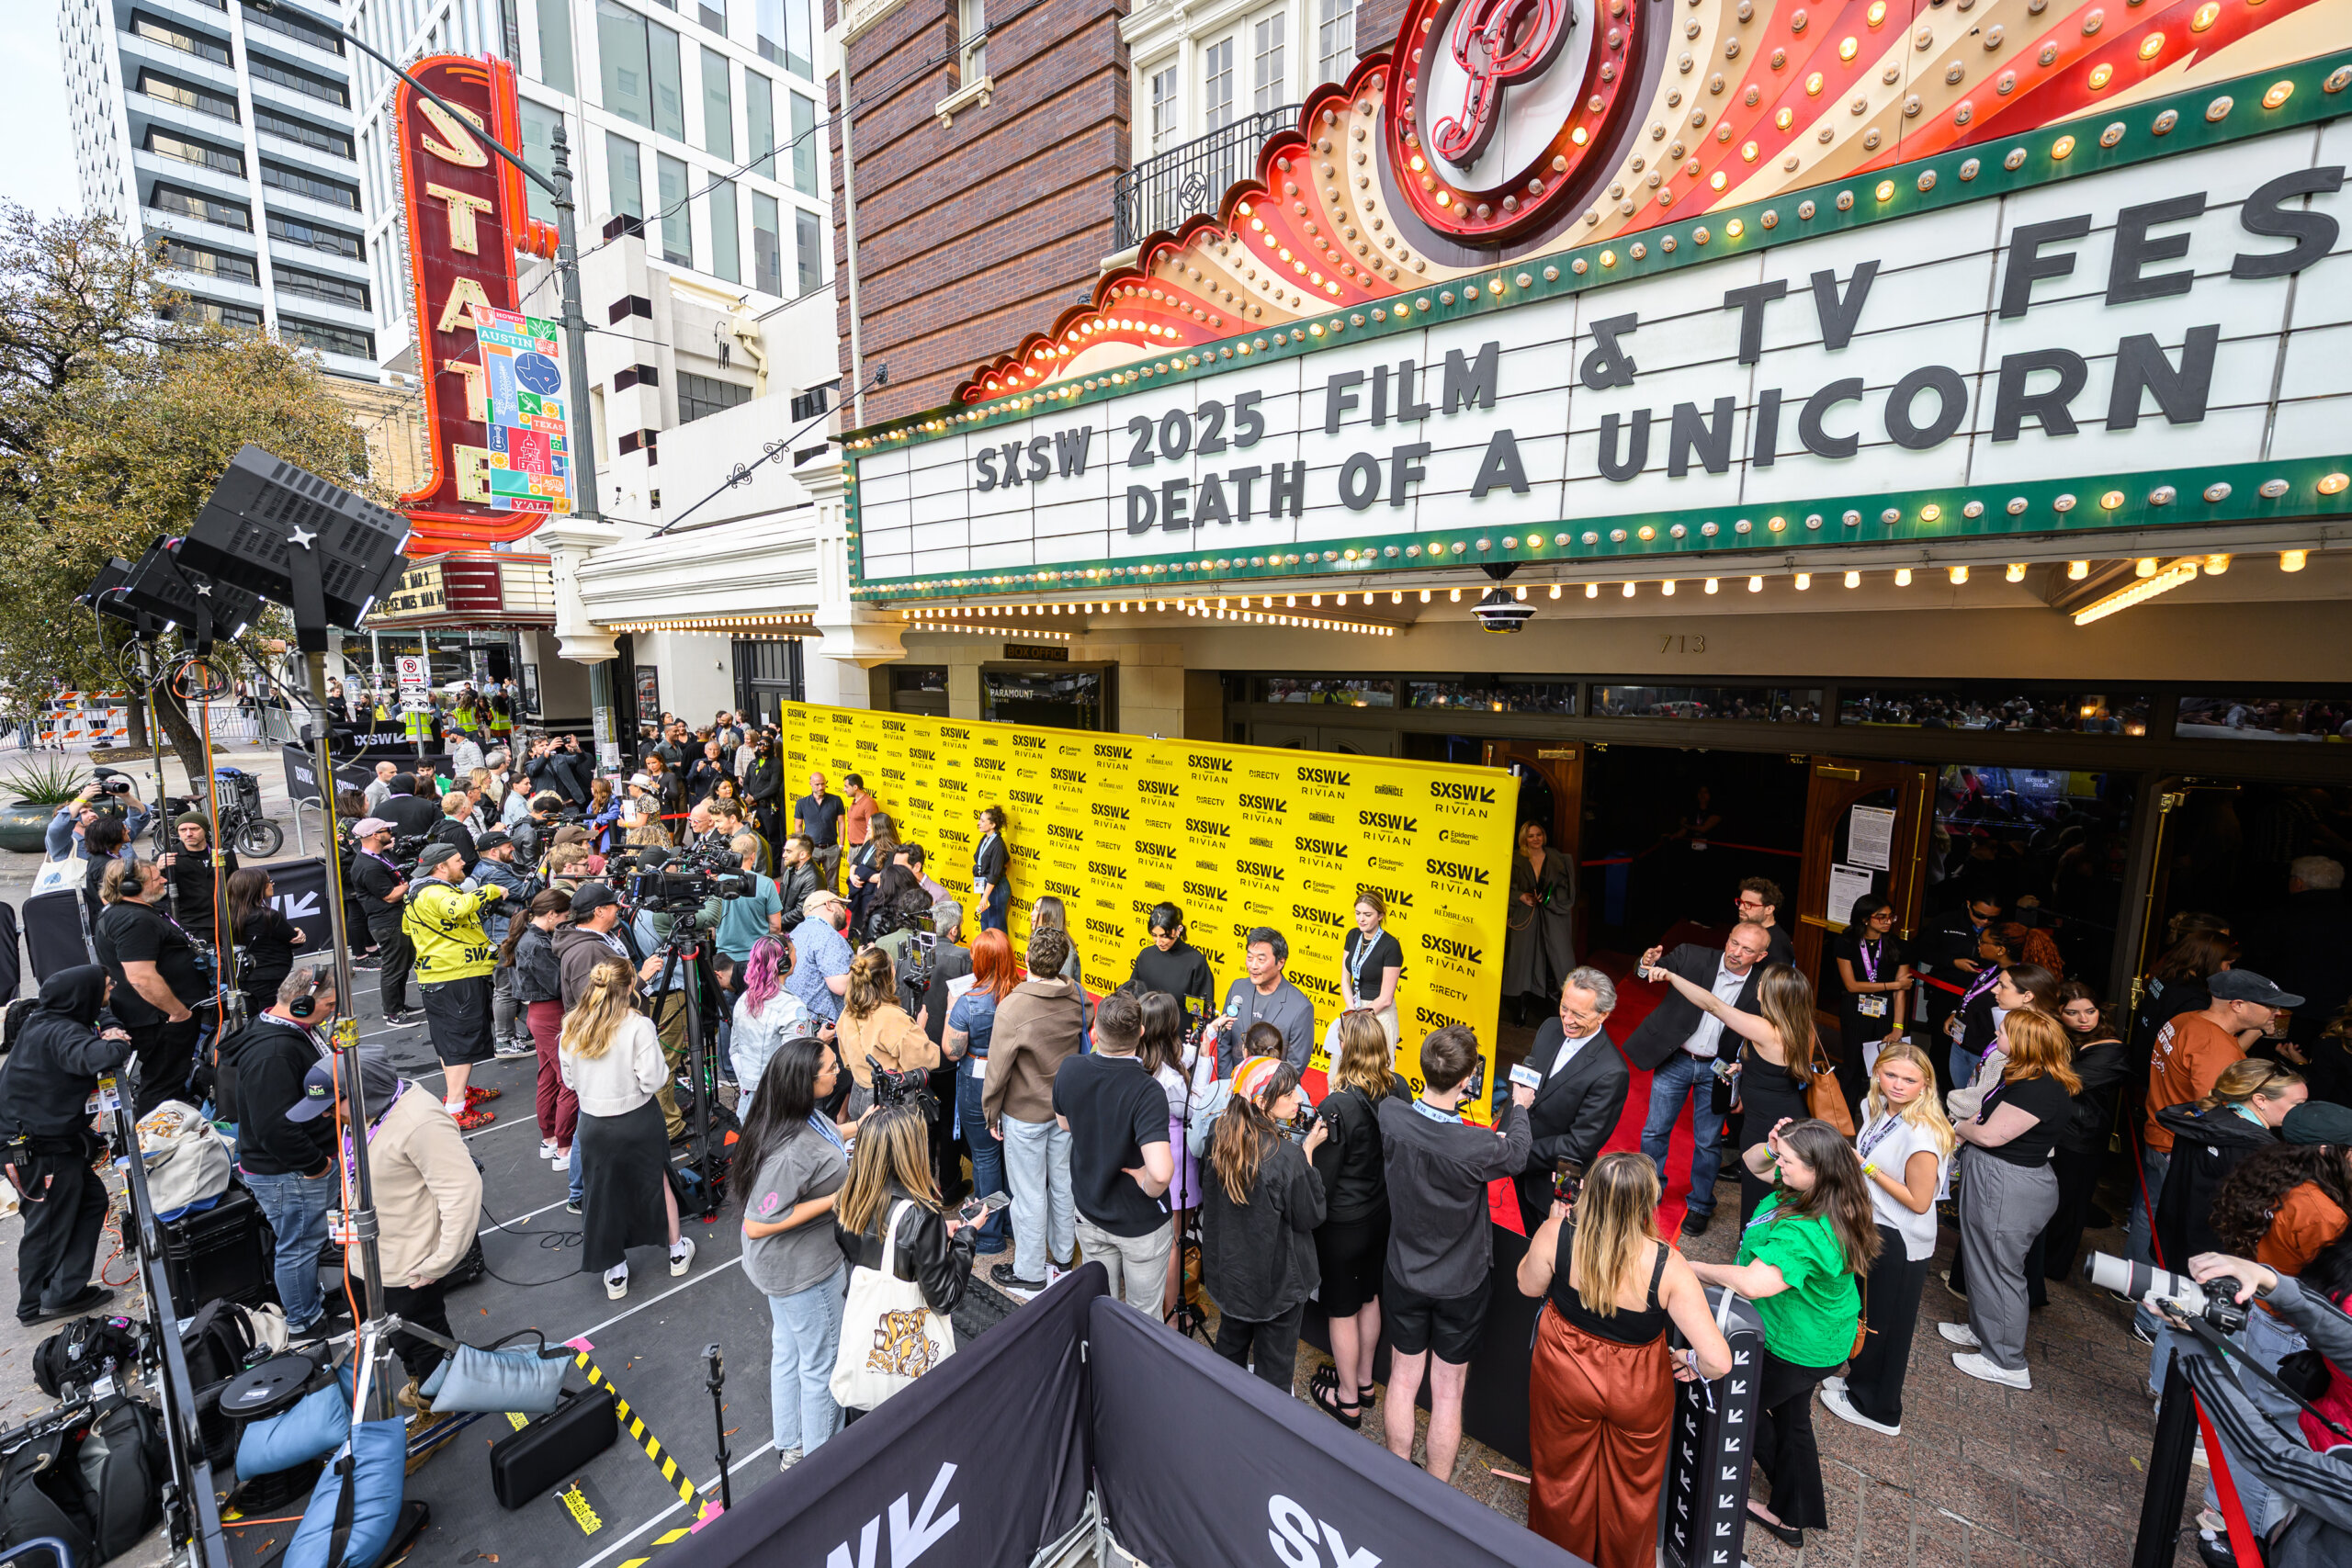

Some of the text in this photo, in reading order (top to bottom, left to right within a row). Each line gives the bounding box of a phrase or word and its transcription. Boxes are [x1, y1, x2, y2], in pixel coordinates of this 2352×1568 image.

[417, 97, 492, 503] STATE
[496, 312, 525, 322] HOWDY
[975, 166, 2345, 492] SXSW 2025 FILM & TV FES
[481, 330, 533, 349] AUSTIN
[534, 419, 564, 432] TEXAS
[1127, 323, 2220, 535] DEATH OF A UNICORN
[514, 500, 550, 512] Y'ALL
[1660, 634, 1705, 654] 713
[1007, 647, 1067, 660] BOX OFFICE
[990, 689, 1034, 699] PARAMOUNT
[787, 708, 801, 720] SXSW
[832, 714, 847, 724] SXSW
[882, 720, 899, 731] SXSW
[809, 733, 823, 743] SXSW
[941, 727, 963, 739] SXSW
[856, 739, 873, 752] SXSW
[943, 741, 967, 750] RIVIAN
[1012, 735, 1037, 748] SXSW
[788, 750, 802, 761] SXSW
[910, 748, 929, 760] SXSW
[1015, 750, 1042, 759] RIVIAN
[1094, 744, 1122, 760] SXSW
[831, 759, 846, 769] SXSW
[911, 761, 933, 770] RIVIAN
[974, 757, 997, 772] SXSW
[1097, 761, 1128, 771] RIVIAN
[1188, 754, 1220, 772] SXSW
[881, 767, 899, 781] SXSW
[976, 773, 1001, 781] RIVIAN
[1051, 767, 1078, 784] SXSW
[1192, 773, 1227, 784] RIVIAN
[1250, 770, 1279, 780] DIRECTV
[1297, 766, 1337, 786] SXSW
[939, 778, 960, 792] SXSW
[1053, 784, 1082, 794] RIVIAN
[1137, 779, 1168, 796] SXSW
[1374, 785, 1403, 797] CHRONICLE
[942, 793, 965, 801] RIVIAN
[1009, 789, 1034, 805] SXSW
[1302, 787, 1344, 799] RIVIAN
[1430, 781, 1478, 804] SXSW
[909, 797, 927, 811] SXSW
[1141, 797, 1174, 807] RIVIAN
[1196, 795, 1225, 807] DIRECTV
[1238, 794, 1274, 813] SXSW
[911, 811, 931, 820] RIVIAN
[1012, 806, 1039, 815] RIVIAN
[1091, 803, 1120, 820] SXSW
[1435, 804, 1487, 818] RIVIAN
[1094, 819, 1125, 830] RIVIAN
[1146, 819, 1171, 829] DIRECTV
[1243, 813, 1282, 825] RIVIAN
[1309, 812, 1335, 824] CHRONICLE
[1359, 810, 1402, 832] SXSW
[1047, 824, 1074, 841] SXSW
[1186, 818, 1218, 837] SXSW
[939, 829, 962, 843] SXSW
[1363, 831, 1410, 846] RIVIAN
[1451, 830, 1478, 840] Epidemic
[1451, 837, 1470, 845] Sound
[942, 843, 967, 852] RIVIAN
[1050, 840, 1080, 852] RIVIAN
[1096, 840, 1121, 851] DIRECTV
[1190, 836, 1226, 849] RIVIAN
[1250, 837, 1272, 848] CHRONICLE
[1295, 837, 1334, 858] SXSW
[1011, 843, 1031, 859] SXSW
[1135, 840, 1165, 859] SXSW
[1012, 859, 1037, 871] RIVIAN
[1138, 858, 1172, 870] RIVIAN
[1196, 860, 1217, 872] CHRONICLE
[1299, 856, 1342, 871] RIVIAN
[1379, 857, 1404, 866] Epidemic
[1088, 861, 1116, 880] SXSW
[1237, 860, 1272, 881] SXSW
[1426, 859, 1473, 882] SXSW
[940, 877, 963, 892] SXSW
[1045, 880, 1071, 898] SXSW
[1091, 878, 1122, 889] RIVIAN
[1240, 878, 1279, 892] RIVIAN
[1313, 881, 1336, 890] Epidemic
[1431, 881, 1482, 899] RIVIAN
[1183, 881, 1216, 901] SXSW
[1011, 897, 1033, 912] SXSW
[1133, 900, 1155, 915] SXS
[1186, 898, 1223, 912] RIVIAN
[1253, 902, 1273, 911] Epidemic
[1012, 911, 1030, 922] RIVIA
[1292, 904, 1330, 928] SXSW
[1434, 908, 1474, 924] REDBREAST
[1086, 919, 1114, 936] SXSW
[1199, 921, 1218, 931] Epidemic
[1296, 924, 1339, 940] RIVIAN
[1089, 934, 1121, 948] RIVIAN
[1421, 933, 1467, 959] SXSW
[1426, 955, 1475, 977] RIVIAN
[1084, 974, 1114, 990] SXSW
[1288, 970, 1328, 996] SXSW
[1430, 983, 1467, 1001] DIRECTV
[572, 1503, 588, 1517] STEP
[580, 1513, 594, 1526] NOT
[586, 1521, 599, 1532] DO
